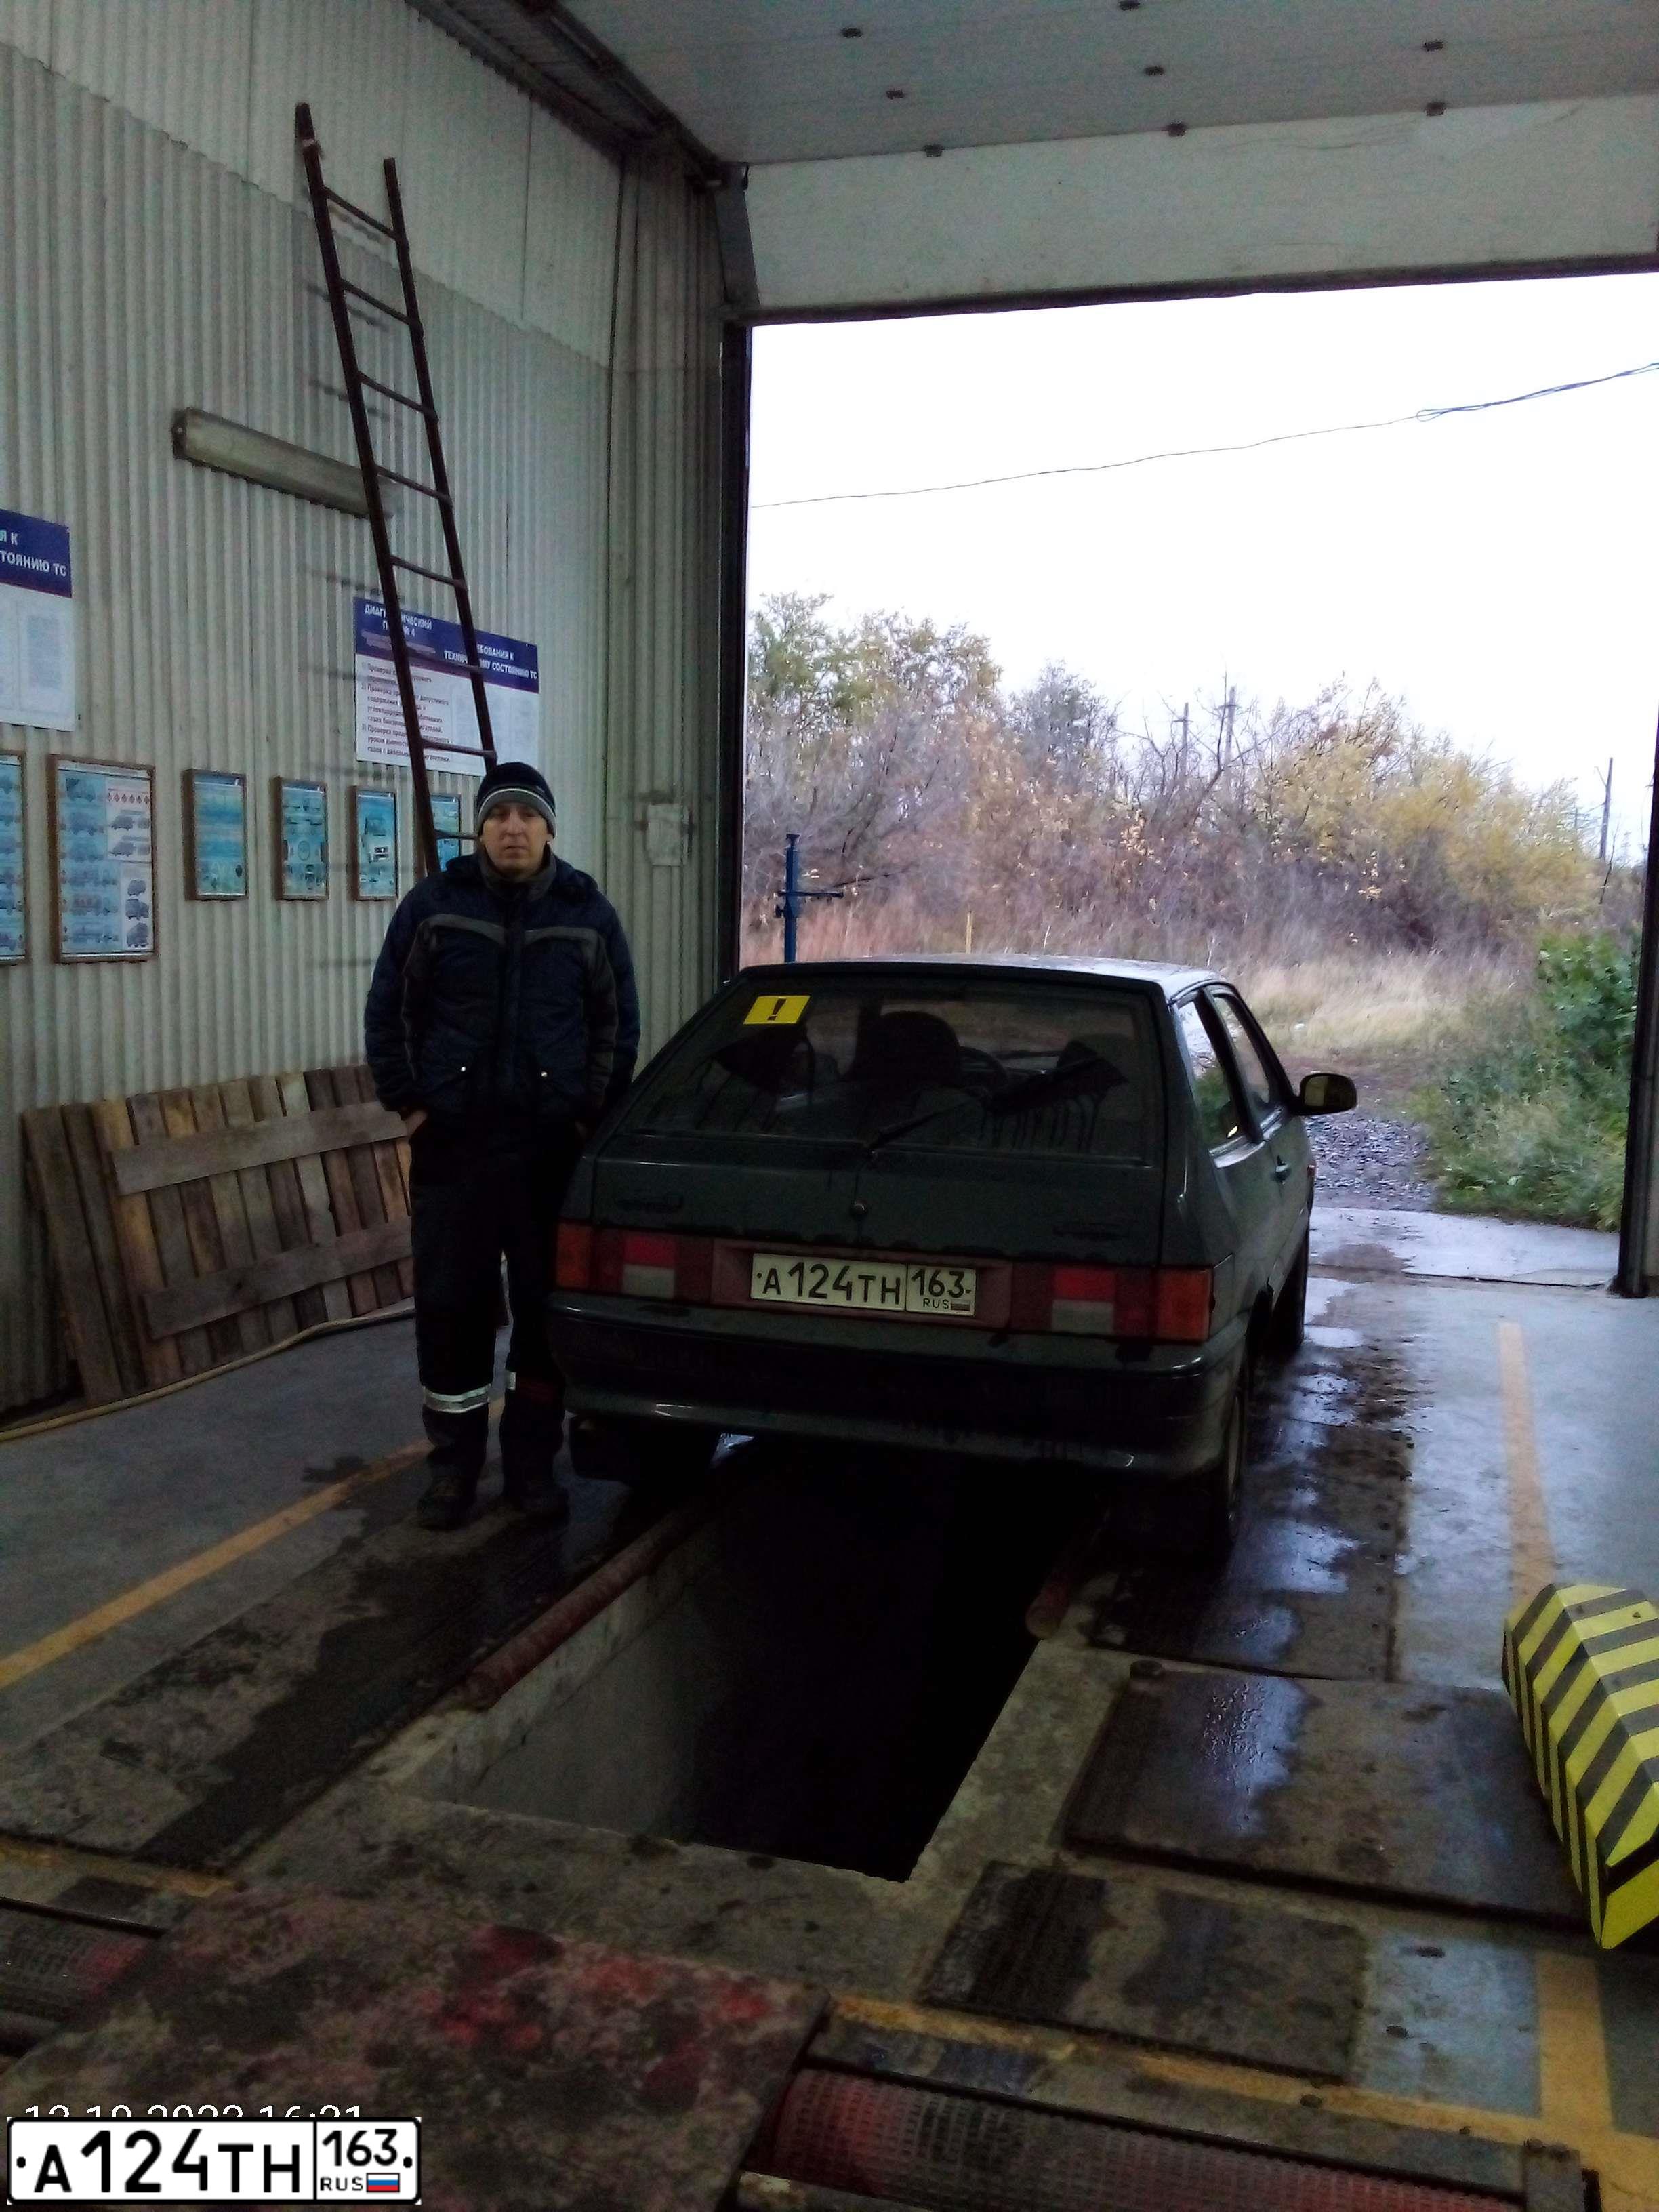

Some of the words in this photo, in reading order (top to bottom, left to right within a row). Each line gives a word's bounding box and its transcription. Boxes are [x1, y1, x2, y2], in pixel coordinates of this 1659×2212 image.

[11, 532, 18, 545] К
[53, 563, 66, 577] ТС
[492, 661, 529, 678] СОСТОЯНИЮ
[530, 670, 537, 680] ТС
[762, 1262, 901, 1305] А124ТН
[912, 1269, 964, 1298] 163
[923, 1298, 949, 1309] RUS
